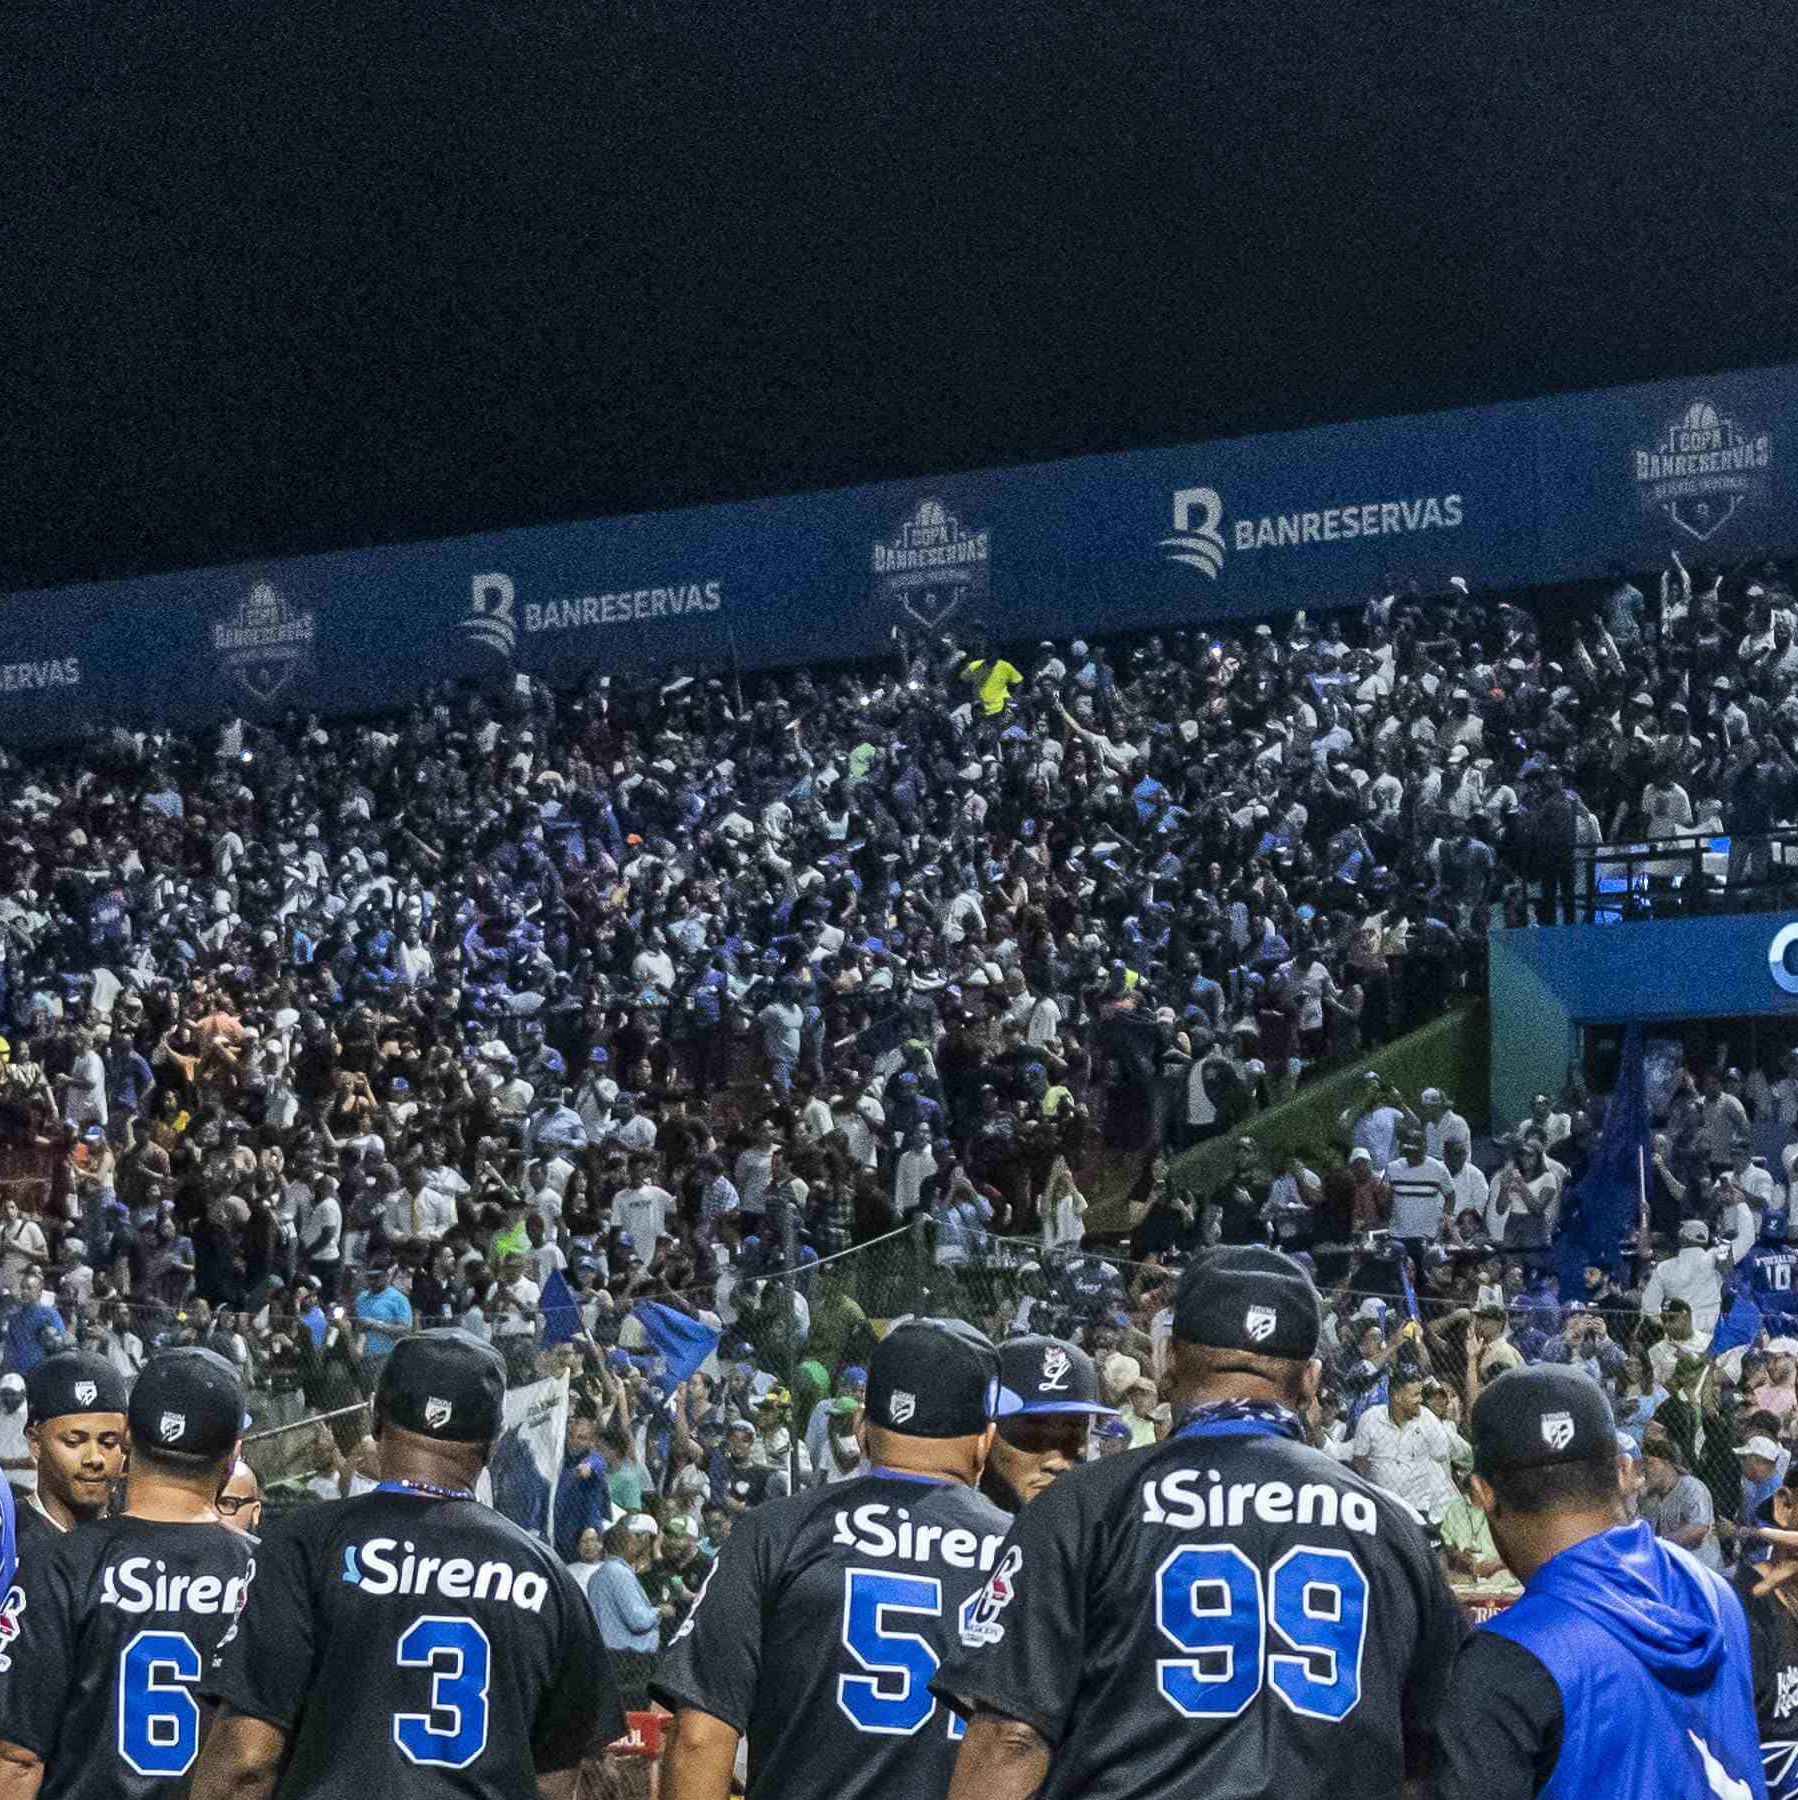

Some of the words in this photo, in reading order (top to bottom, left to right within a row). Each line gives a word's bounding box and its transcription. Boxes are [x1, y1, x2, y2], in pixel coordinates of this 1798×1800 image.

[1636, 436, 1769, 479] BANRESERVAS
[1235, 494, 1464, 551] BANRESERVAS
[525, 580, 721, 633] BANRESERVAS
[1160, 1468, 1378, 1536] Sirena
[359, 1538, 549, 1614] Sirena
[1155, 1543, 1370, 1722] 99
[393, 1615, 491, 1769] 3
